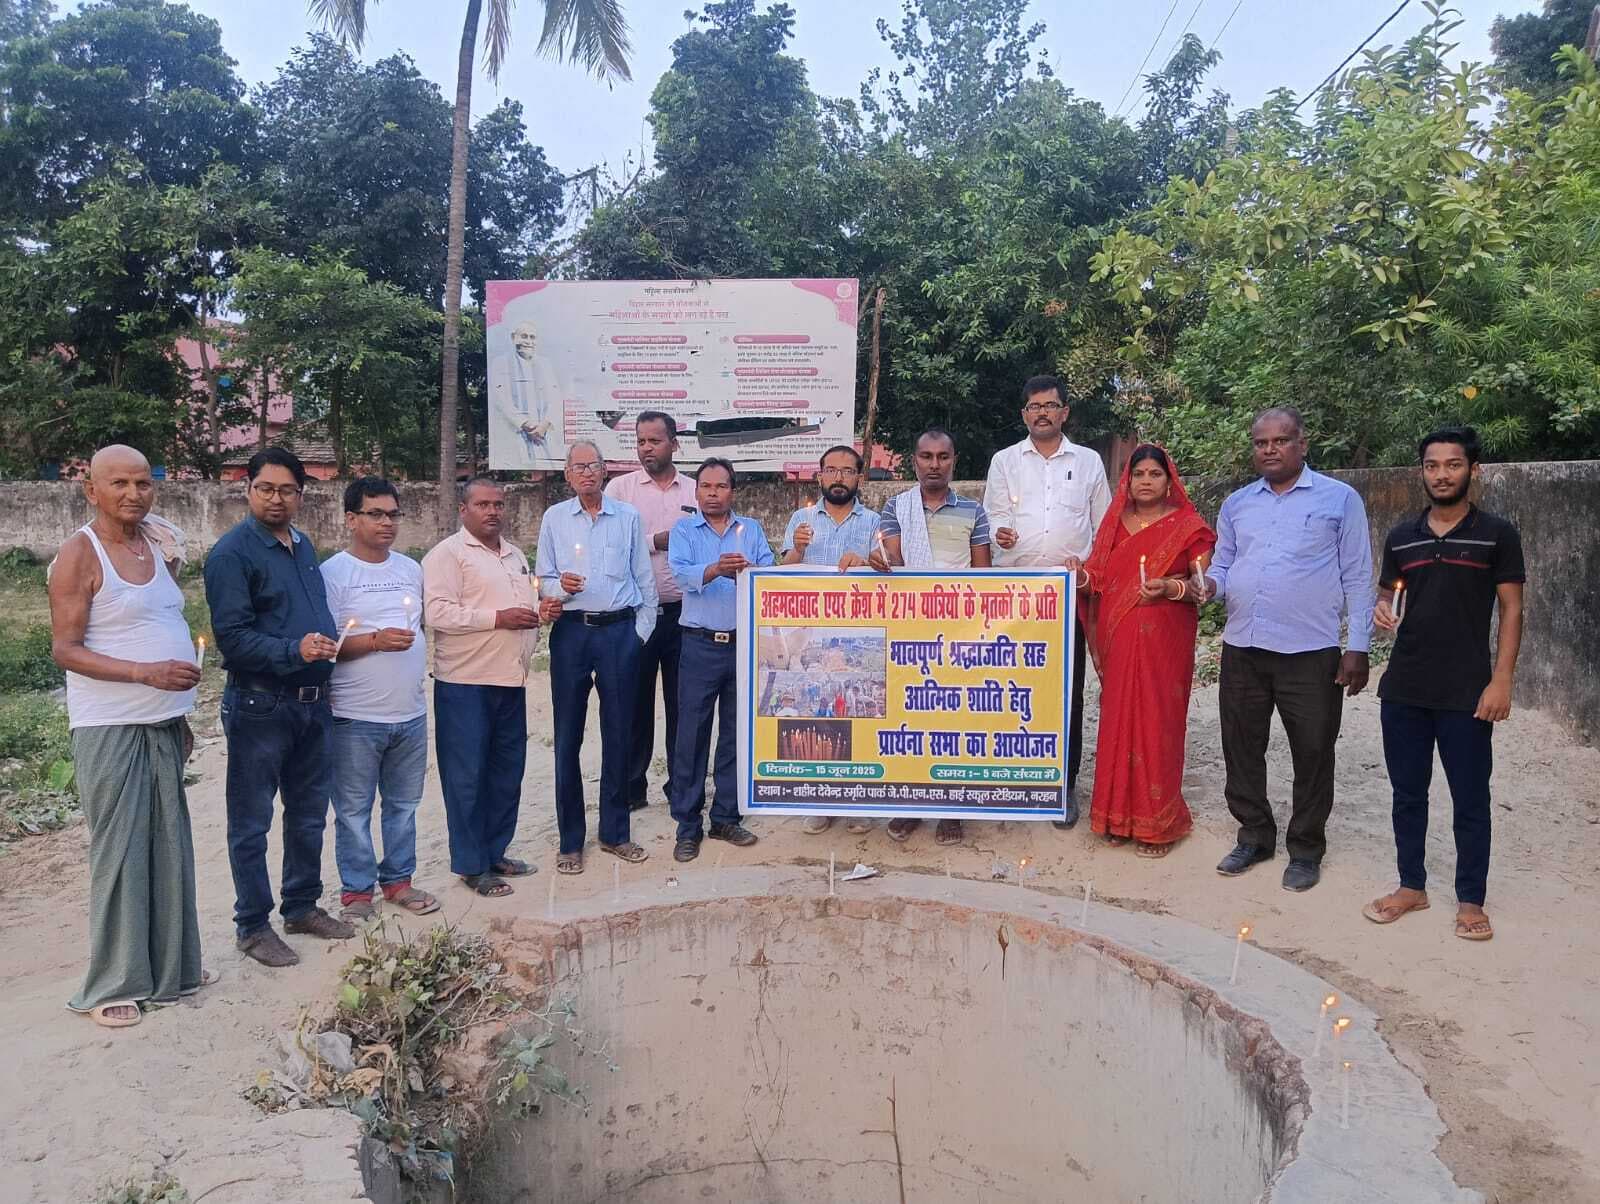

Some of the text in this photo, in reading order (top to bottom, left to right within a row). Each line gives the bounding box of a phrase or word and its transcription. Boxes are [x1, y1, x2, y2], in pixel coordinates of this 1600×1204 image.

[761, 583, 1058, 629] अहमदाबाद एयर क्रैश में 274 यात्रियों के मृतकों के प्रति
[890, 634, 1047, 675] भावपूर्ण श्रद्धांजलि सह
[904, 679, 1032, 721] आत्मिक शांति हेतु
[878, 723, 1057, 758] प्रार्थना सभा का आयोजन
[816, 765, 826, 774] 15
[828, 766, 850, 777] जून
[852, 766, 876, 776] 2025
[936, 768, 966, 778] समय
[983, 768, 989, 778] 5
[991, 768, 1010, 779] बजे
[1044, 768, 1056, 780] में
[758, 785, 781, 797] स्थान
[793, 783, 816, 798] शहीद
[843, 784, 866, 801] स्मृति
[868, 785, 887, 799] पार्क
[949, 786, 965, 802] हाई
[966, 789, 990, 804] स्कूल
